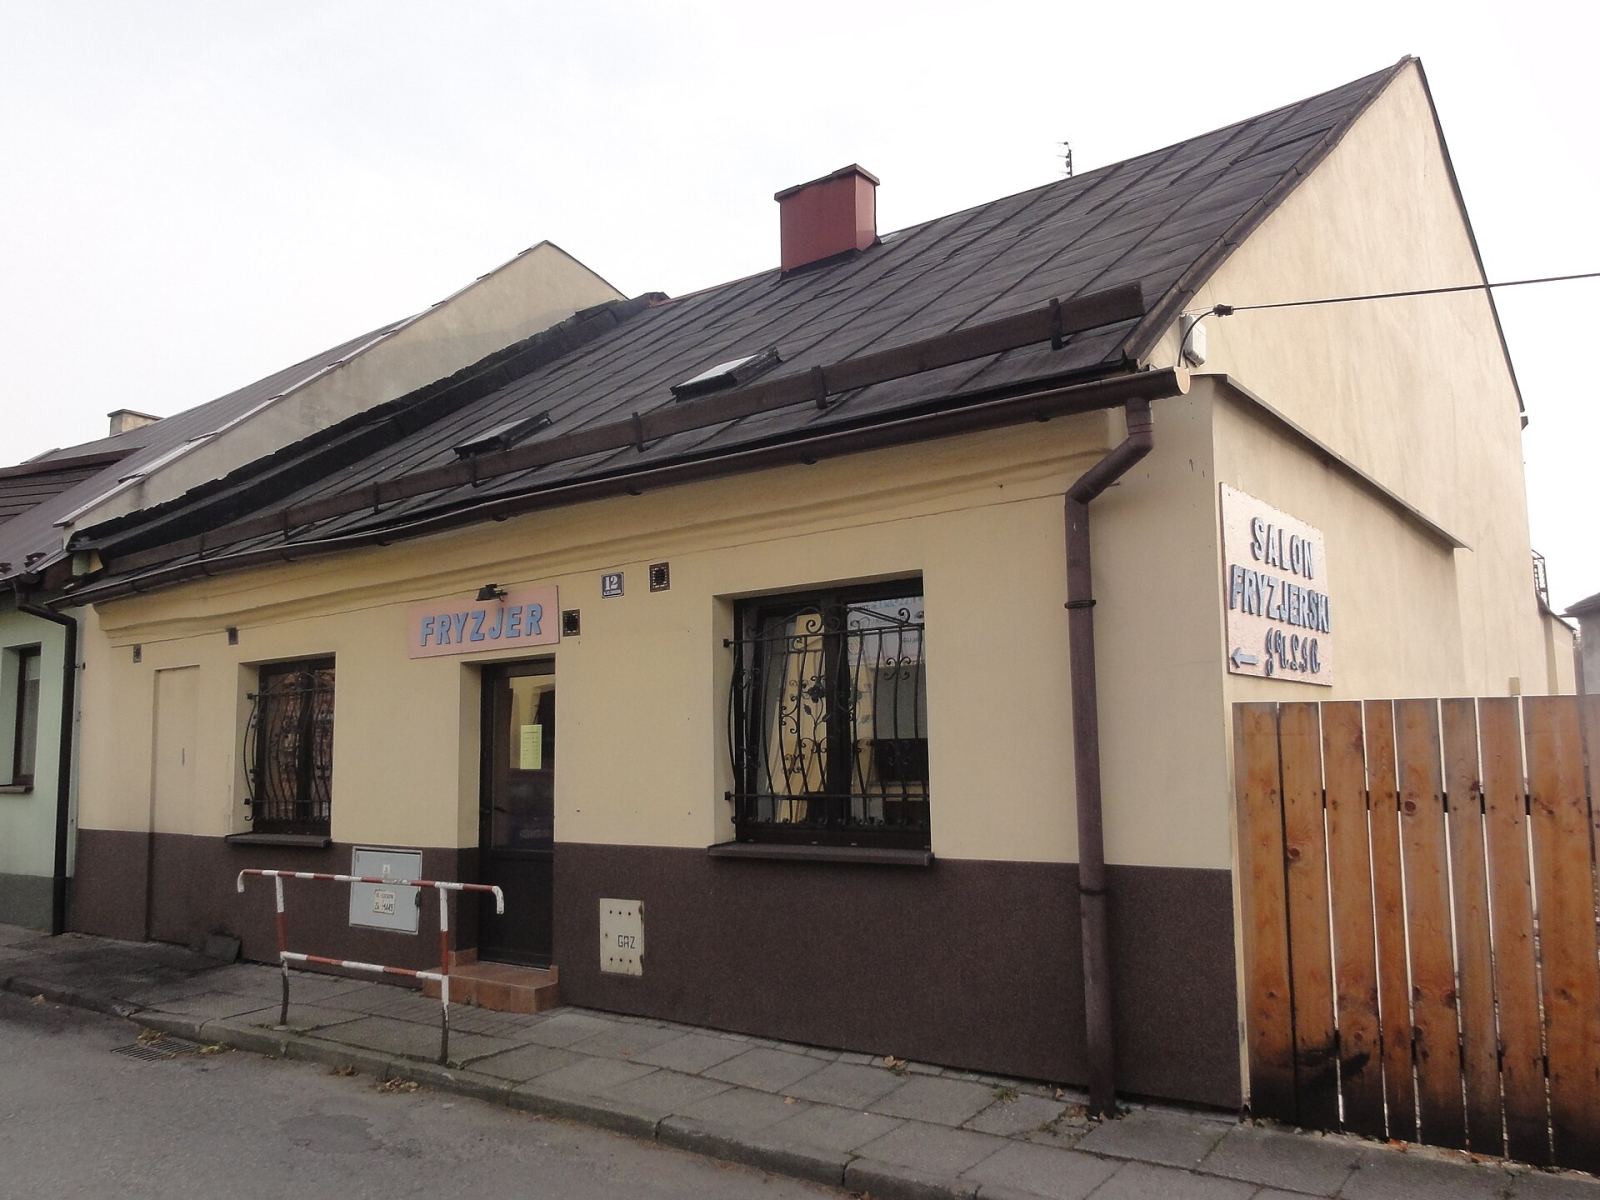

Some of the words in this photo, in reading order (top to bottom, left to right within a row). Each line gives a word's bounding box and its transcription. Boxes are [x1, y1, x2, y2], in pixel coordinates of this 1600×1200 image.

[1251, 517, 1313, 579] SALON
[605, 575, 618, 590] 12
[420, 603, 543, 646] FRYZJER
[617, 934, 635, 949] GAZ
